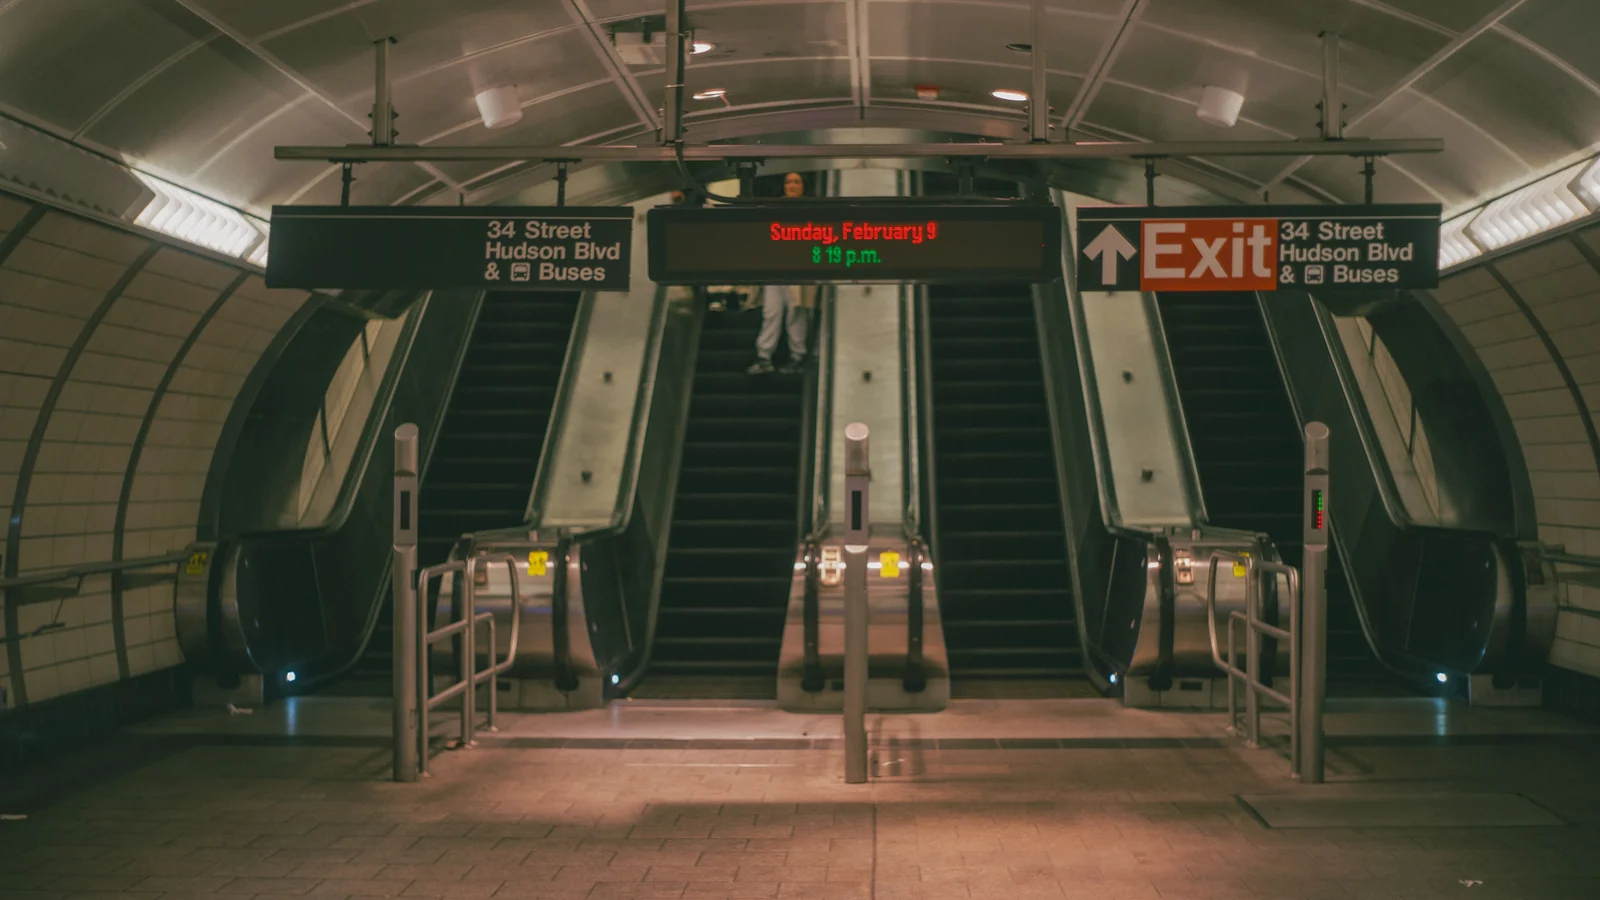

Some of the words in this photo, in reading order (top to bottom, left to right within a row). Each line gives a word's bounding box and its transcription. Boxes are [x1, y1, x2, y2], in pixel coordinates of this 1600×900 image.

[487, 221, 517, 239] 34
[524, 221, 592, 240] Street
[770, 222, 839, 244] Sunday,
[842, 221, 923, 244] February
[926, 221, 937, 240] 9
[1280, 222, 1309, 240] 34
[1317, 221, 1385, 241] Street
[485, 241, 566, 260] Hudson
[574, 242, 621, 260] Blvd
[846, 249, 882, 267] p.m.
[1143, 222, 1272, 279] Exit
[1279, 244, 1359, 262] Hudson
[1367, 243, 1414, 262] Blvd
[484, 262, 500, 281] &
[538, 262, 606, 281] Buses
[1279, 264, 1295, 284] &
[1333, 264, 1399, 284] Buses
